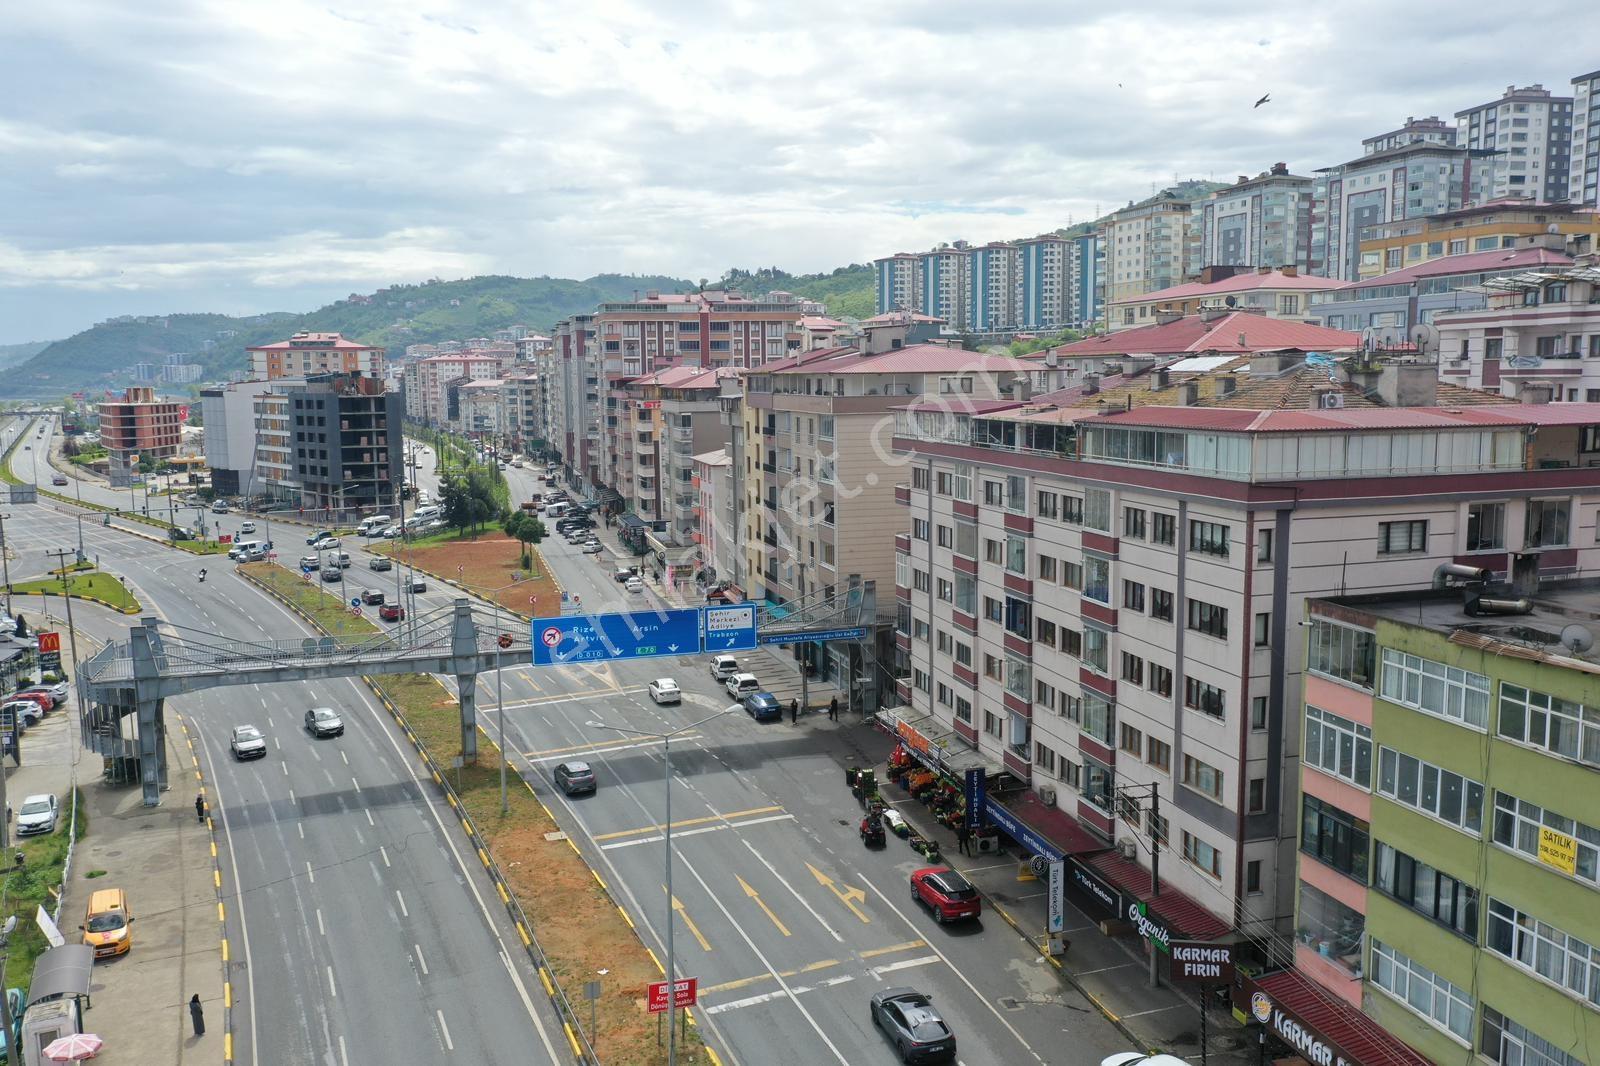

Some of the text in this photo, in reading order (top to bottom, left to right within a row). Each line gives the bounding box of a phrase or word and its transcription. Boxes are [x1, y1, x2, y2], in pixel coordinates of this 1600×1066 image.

[632, 624, 659, 632] Arsin
[574, 635, 606, 643] Artvin
[1543, 830, 1572, 849] SATILIK
[1092, 883, 1113, 905] Telekom
[1128, 903, 1170, 946] Organik
[1173, 947, 1231, 964] KARMAR
[1184, 963, 1221, 977] FIRIN
[1273, 1009, 1333, 1066] KARMAR
